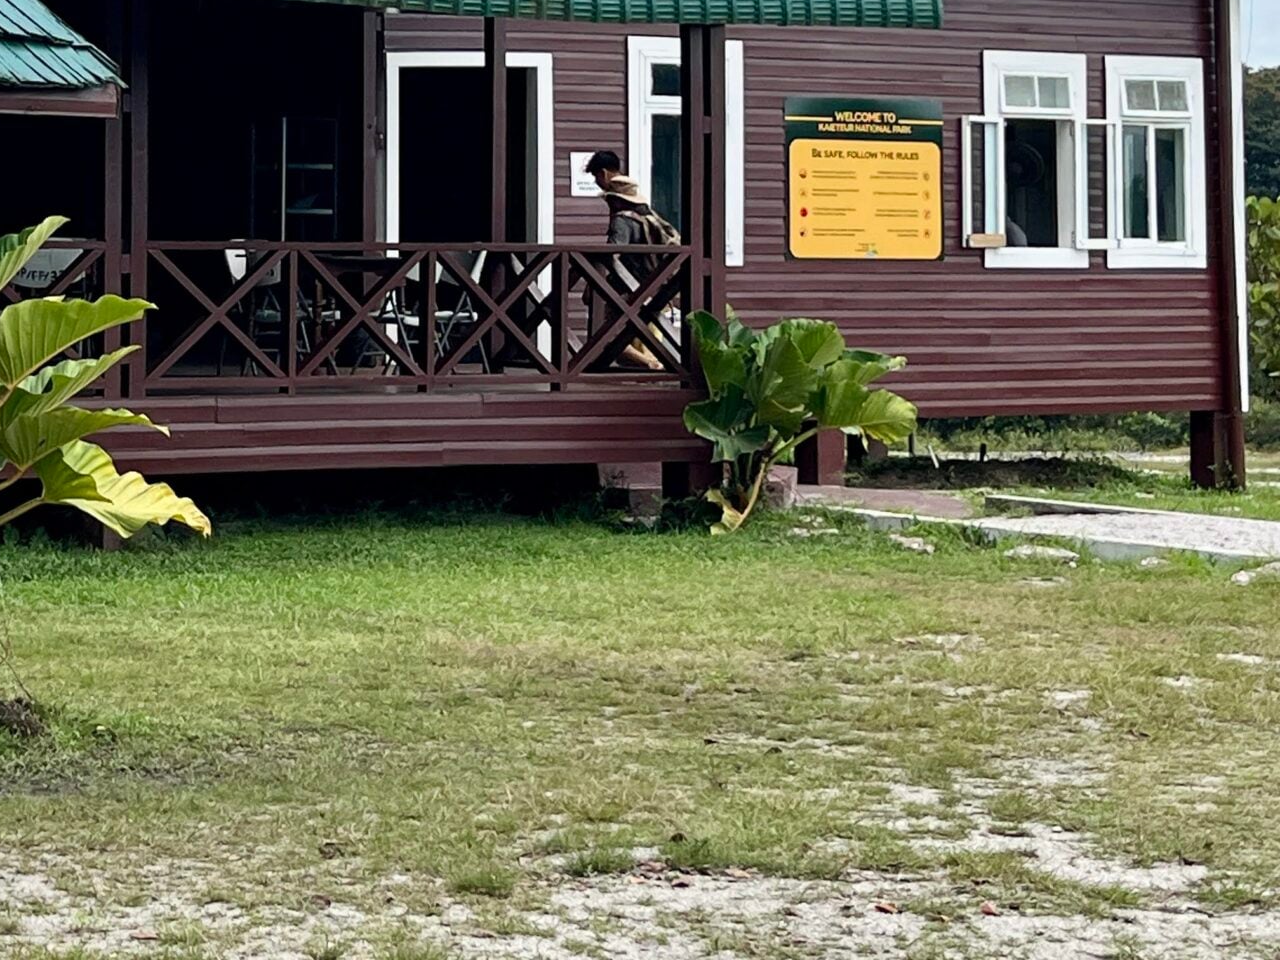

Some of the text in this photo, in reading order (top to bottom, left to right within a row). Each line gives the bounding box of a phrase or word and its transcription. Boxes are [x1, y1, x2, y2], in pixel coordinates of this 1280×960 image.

[834, 111, 896, 124] WELCOME TO
[855, 124, 891, 134] NATIONAL
[846, 150, 878, 159] FOLLOW
[880, 151, 894, 160] THE
[896, 151, 919, 160] RULES
